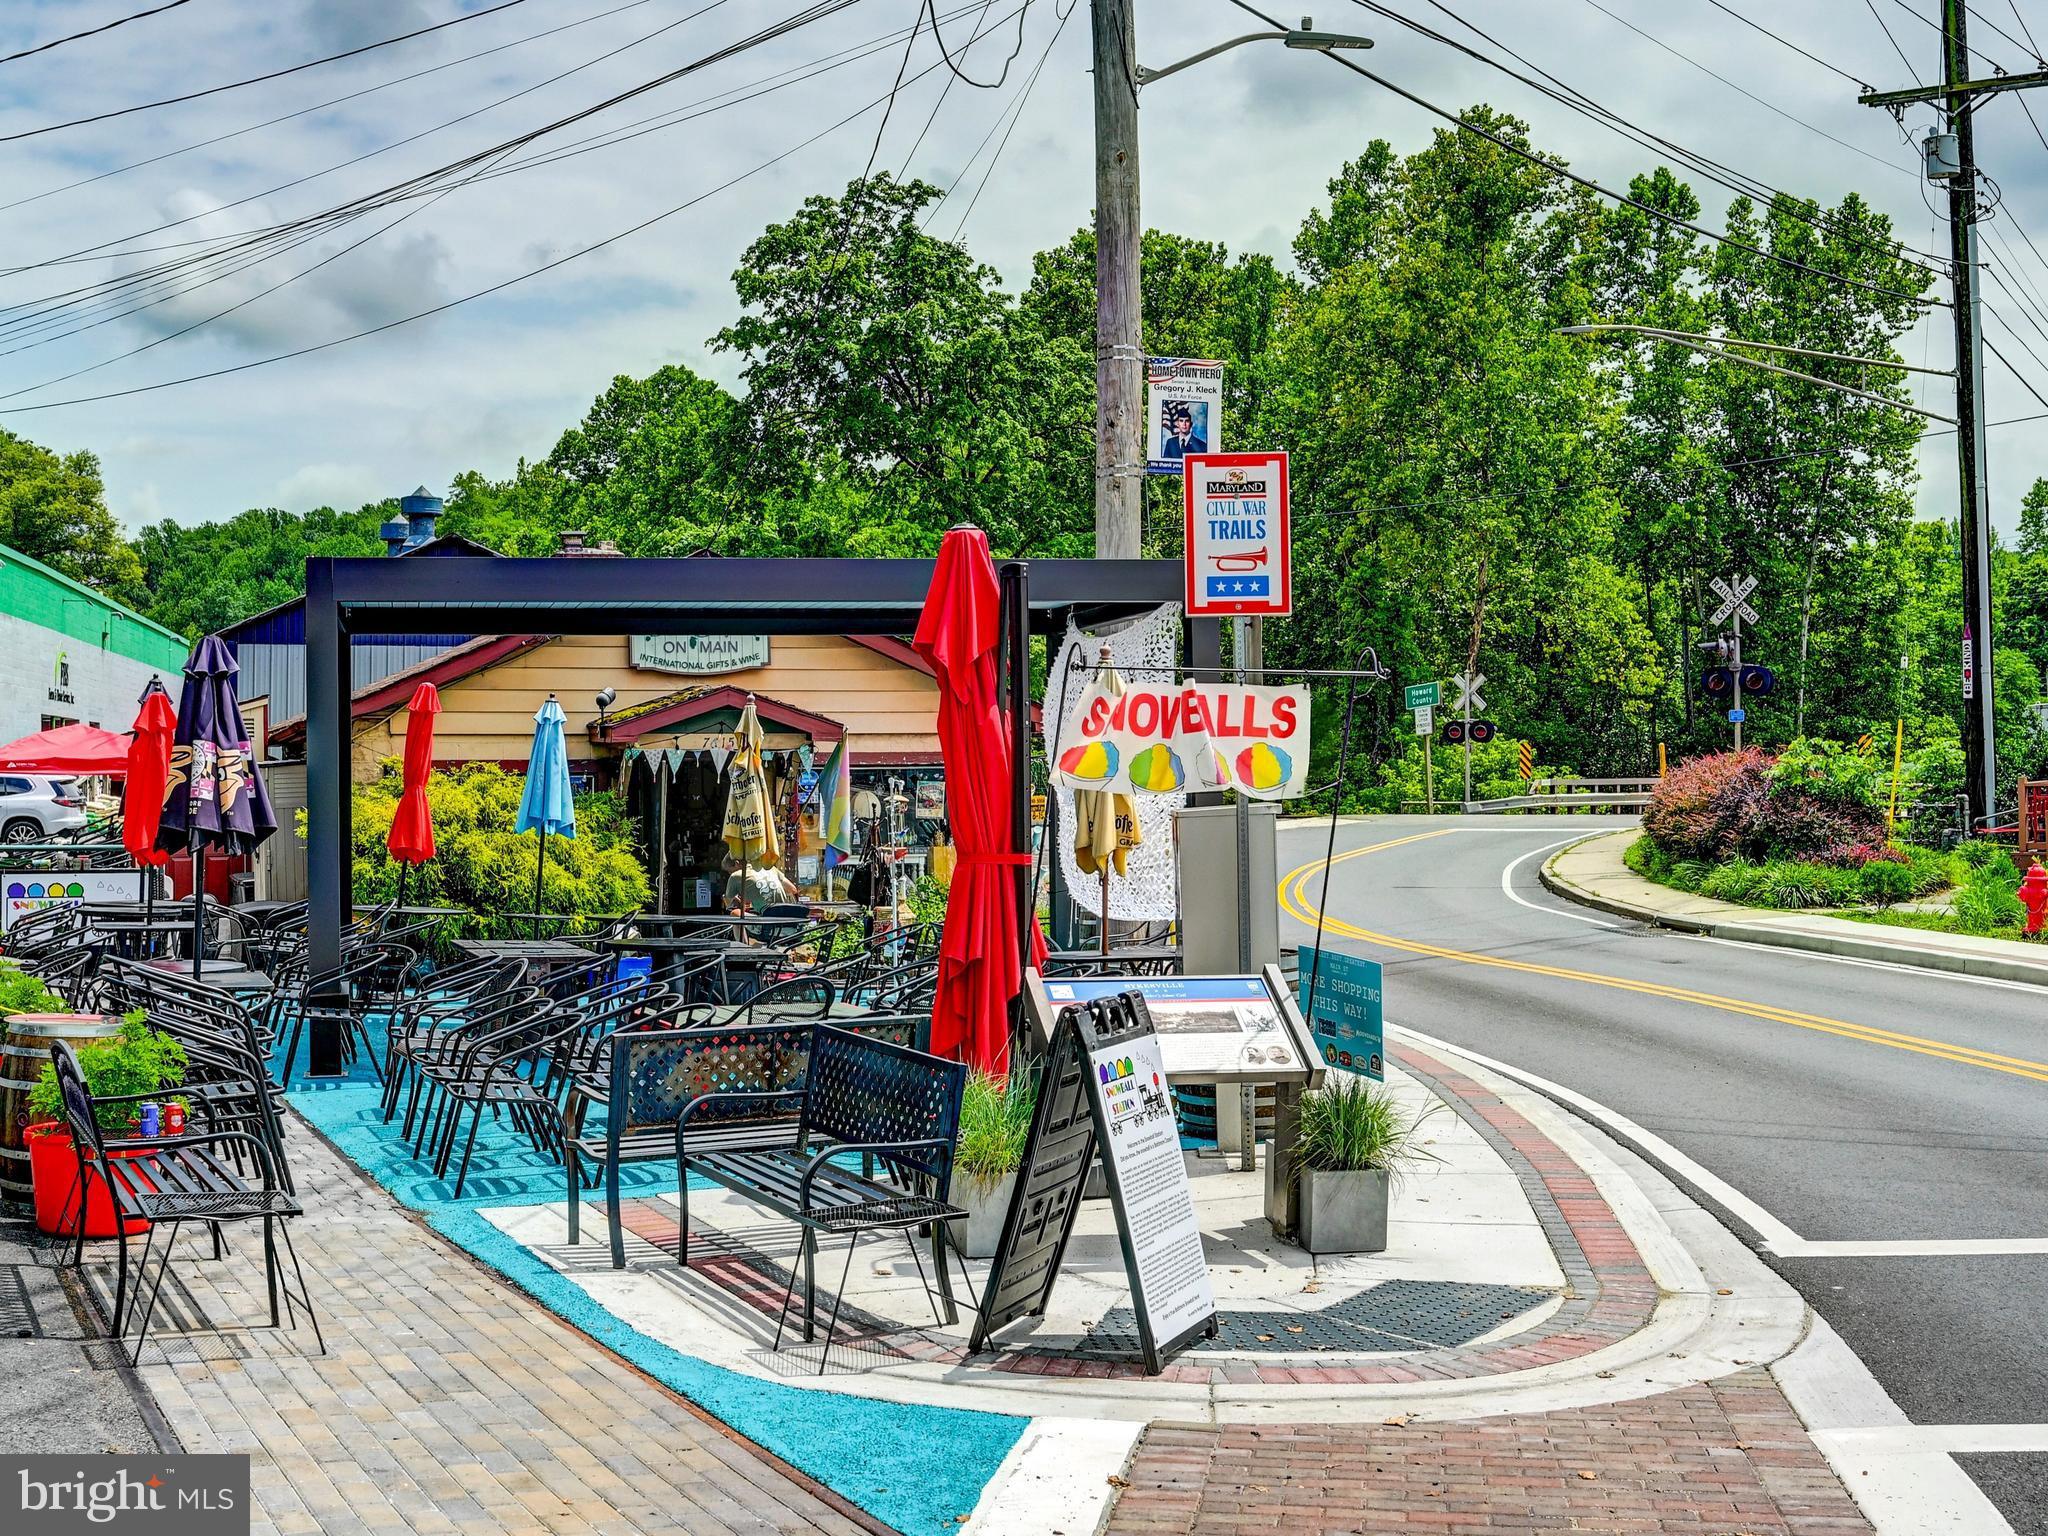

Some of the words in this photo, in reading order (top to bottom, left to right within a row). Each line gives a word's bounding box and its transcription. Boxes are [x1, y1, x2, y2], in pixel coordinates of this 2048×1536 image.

[1152, 365, 1198, 378] HOMETOWN
[1199, 368, 1220, 380] HERO
[1154, 383, 1184, 393] Gregory
[1196, 386, 1217, 394] Kleck
[1209, 482, 1263, 493] MARYLAND
[1207, 501, 1240, 516] CIVIL
[1243, 501, 1266, 516] WAR
[1208, 520, 1266, 540] TRAILS
[1711, 579, 1730, 599] RAIL
[1715, 581, 1753, 621] CROSSING
[663, 641, 686, 653] ON
[700, 641, 738, 653] MAIN
[1963, 643, 1971, 668] KIND
[639, 652, 704, 670] INTERNATIONAL
[707, 660, 729, 670] GIFTS
[731, 659, 737, 667] &
[739, 652, 760, 665] WINE
[1411, 687, 1432, 696] Howard
[1300, 971, 1326, 989] MORE
[1331, 979, 1380, 1003] SHOPPING
[1313, 994, 1338, 1012] THIS
[1344, 1002, 1367, 1020] WAY!
[1105, 1079, 1136, 1099] SNOWBALL
[1112, 1098, 1136, 1115] STATION
